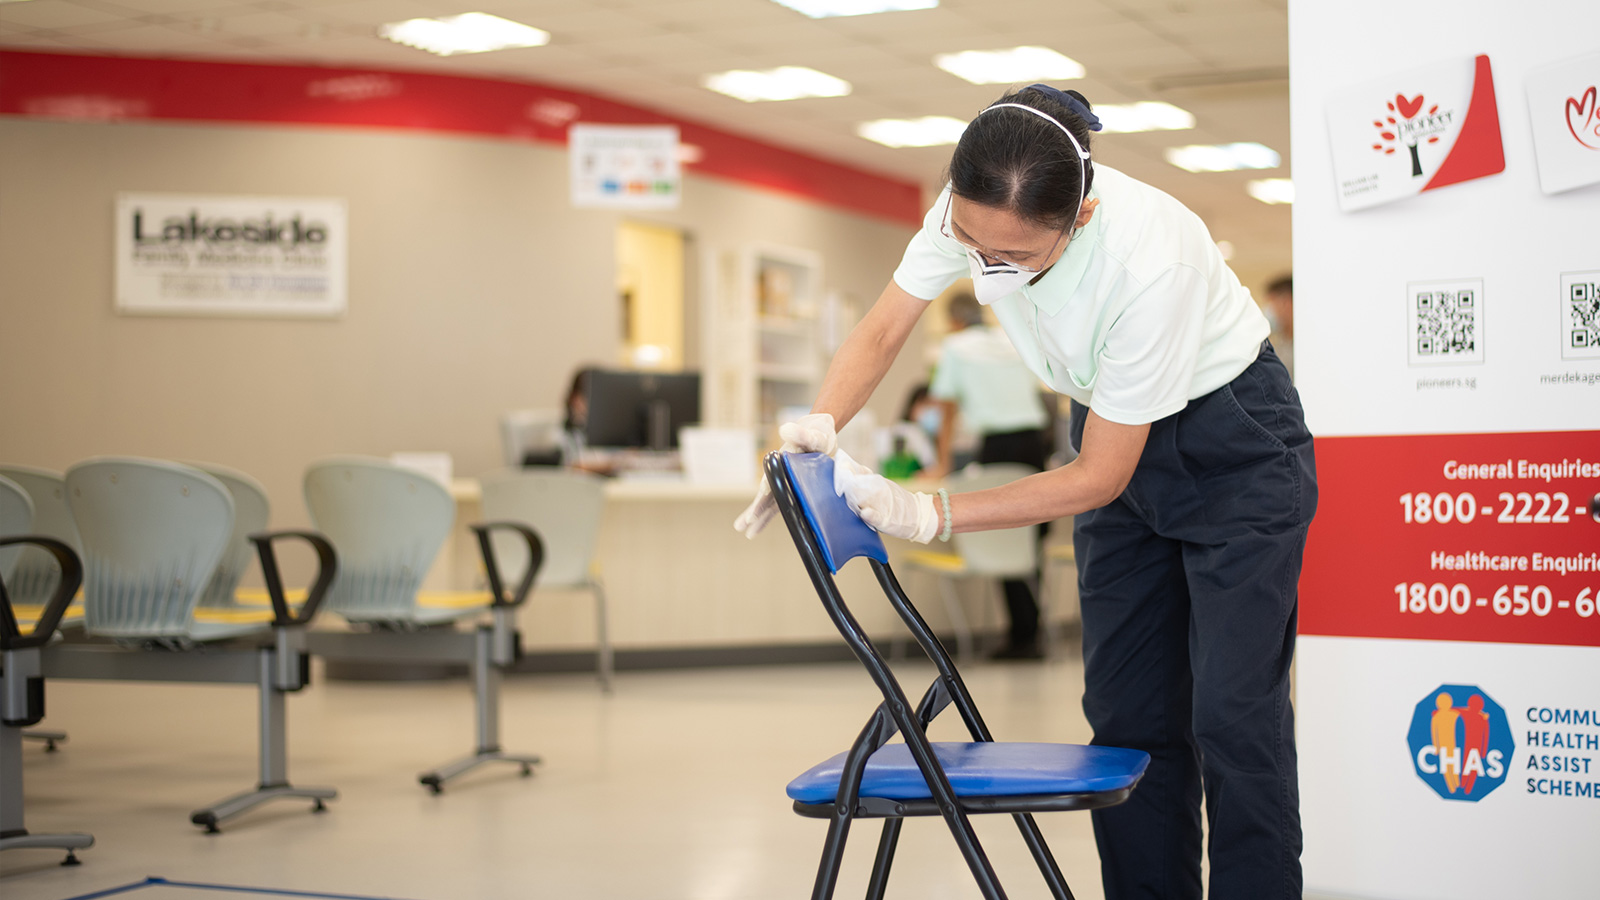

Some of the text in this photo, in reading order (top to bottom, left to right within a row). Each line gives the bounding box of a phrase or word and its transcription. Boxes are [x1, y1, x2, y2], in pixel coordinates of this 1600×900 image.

[1397, 109, 1454, 141] pioneer
[133, 208, 328, 247] Lakeside
[1416, 376, 1477, 391] pioneers.sg
[1540, 370, 1600, 386] merdekage
[1443, 458, 1600, 483] General Enquiries
[1430, 550, 1528, 571] Healthcare
[1526, 707, 1600, 727] COMMU
[1527, 731, 1599, 751] HEALTH
[1417, 745, 1505, 779] CHAS
[1526, 754, 1592, 774] ASSIST
[1526, 777, 1600, 799] SCHEME
